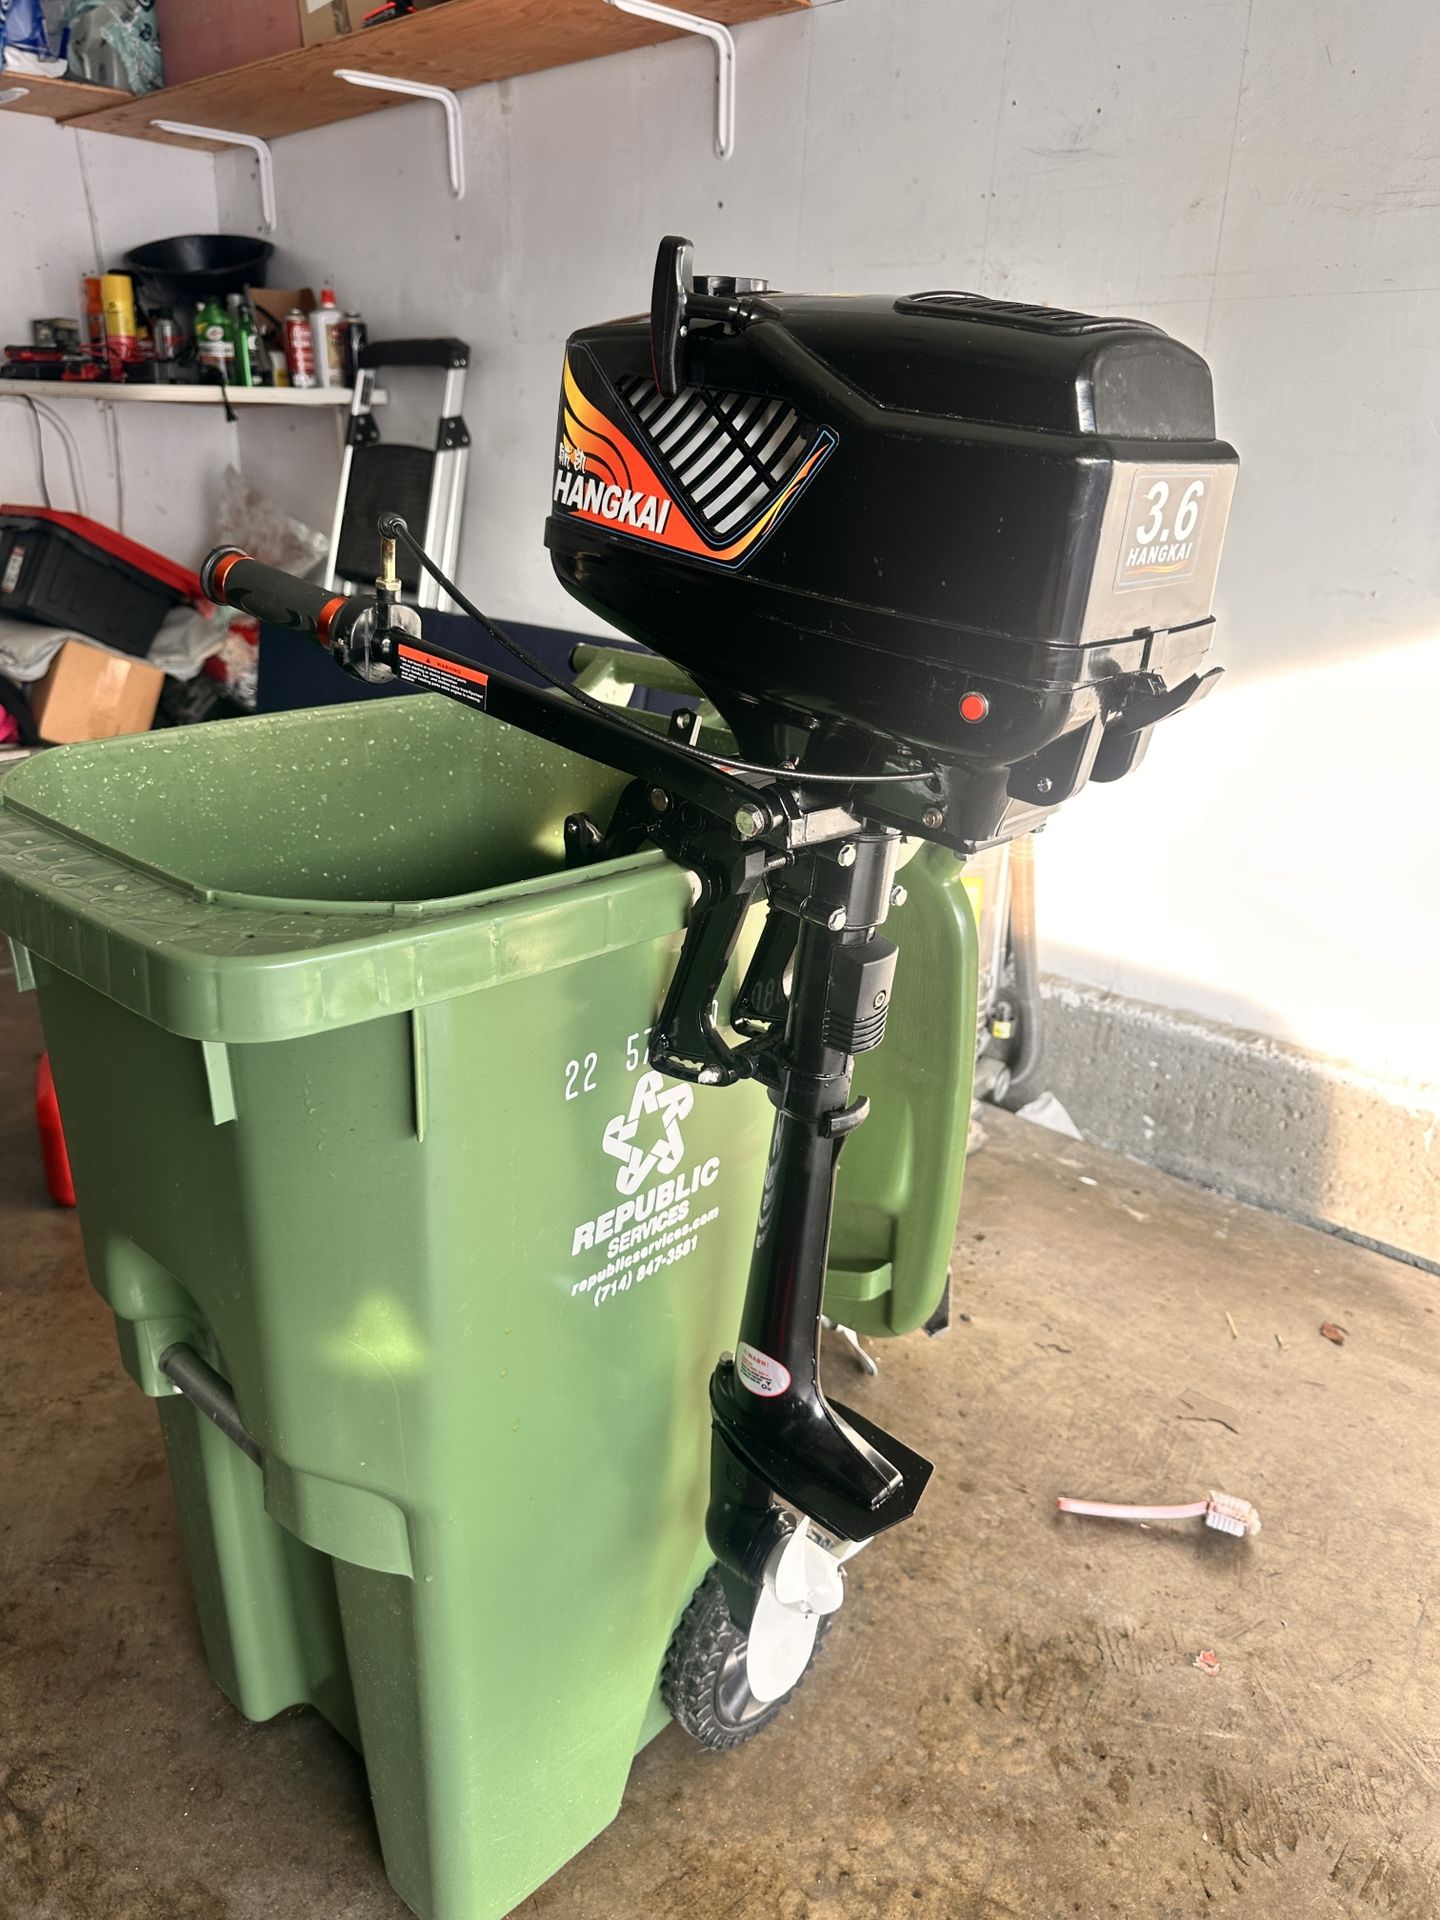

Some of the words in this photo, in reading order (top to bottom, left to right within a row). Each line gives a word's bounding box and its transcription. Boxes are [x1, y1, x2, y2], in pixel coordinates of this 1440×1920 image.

[554, 470, 673, 534] HANGKAI
[1136, 480, 1205, 545] 3.6
[1126, 542, 1193, 567] HANGKAI
[565, 1052, 598, 1101] 22
[571, 1157, 721, 1256] REPUBLIC
[607, 1200, 690, 1259] SERVICES
[571, 1206, 720, 1296] republicservices.com
[594, 1270, 633, 1308] (714)
